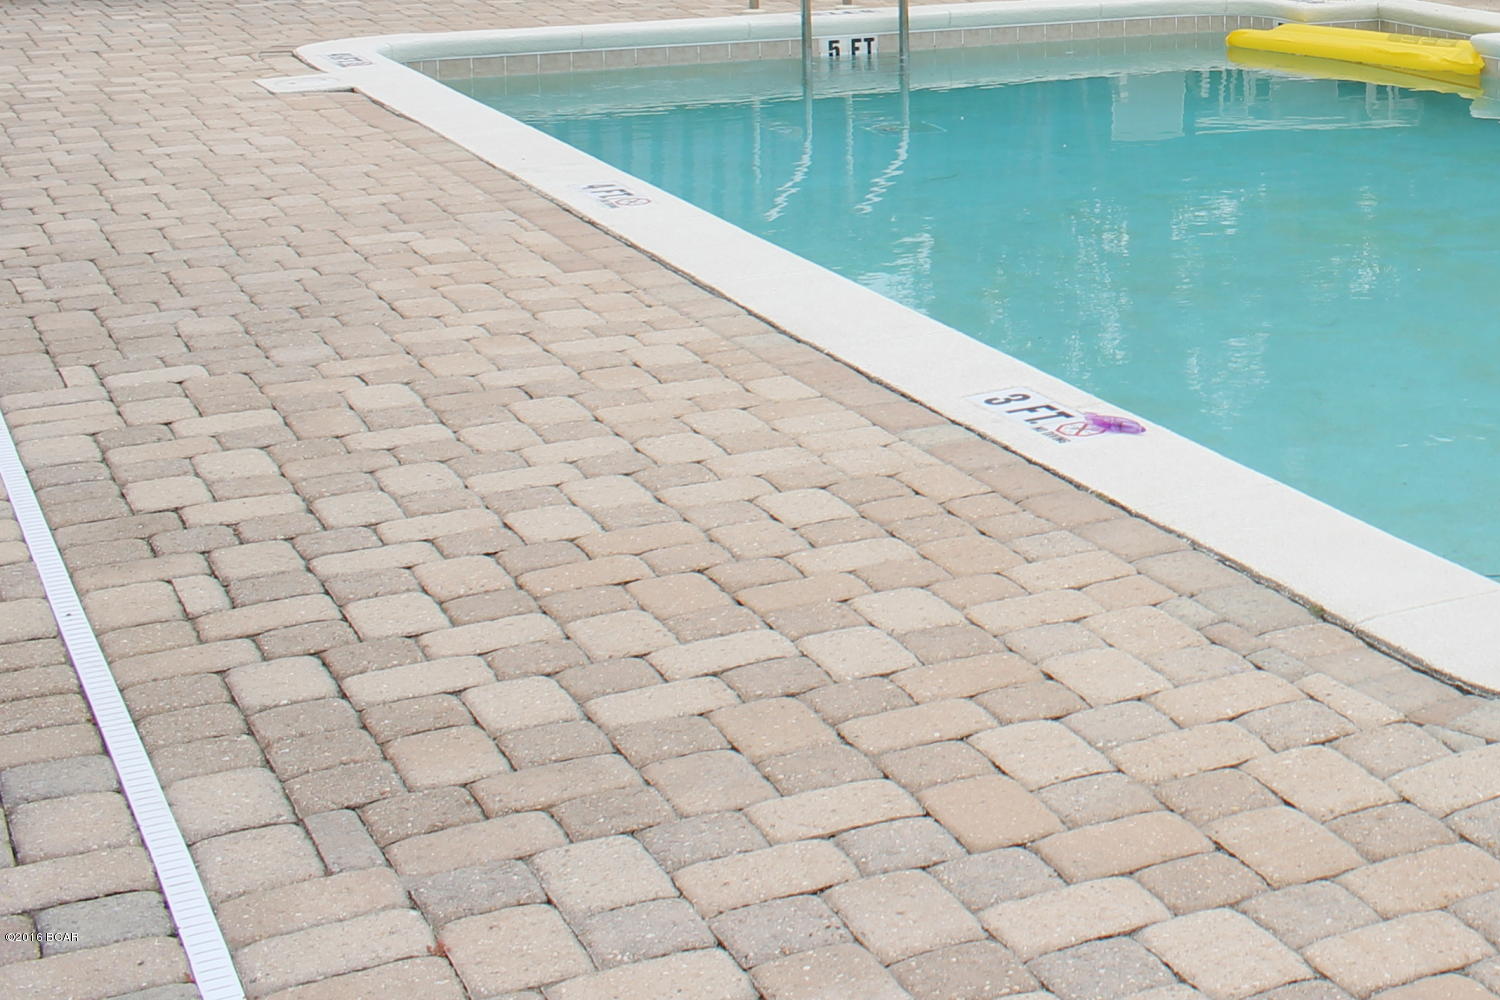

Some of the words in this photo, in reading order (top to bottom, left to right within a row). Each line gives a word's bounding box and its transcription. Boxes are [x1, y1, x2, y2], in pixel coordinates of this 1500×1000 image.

[828, 40, 840, 56] 5
[851, 37, 875, 55] FT
[984, 393, 1031, 405] 3
